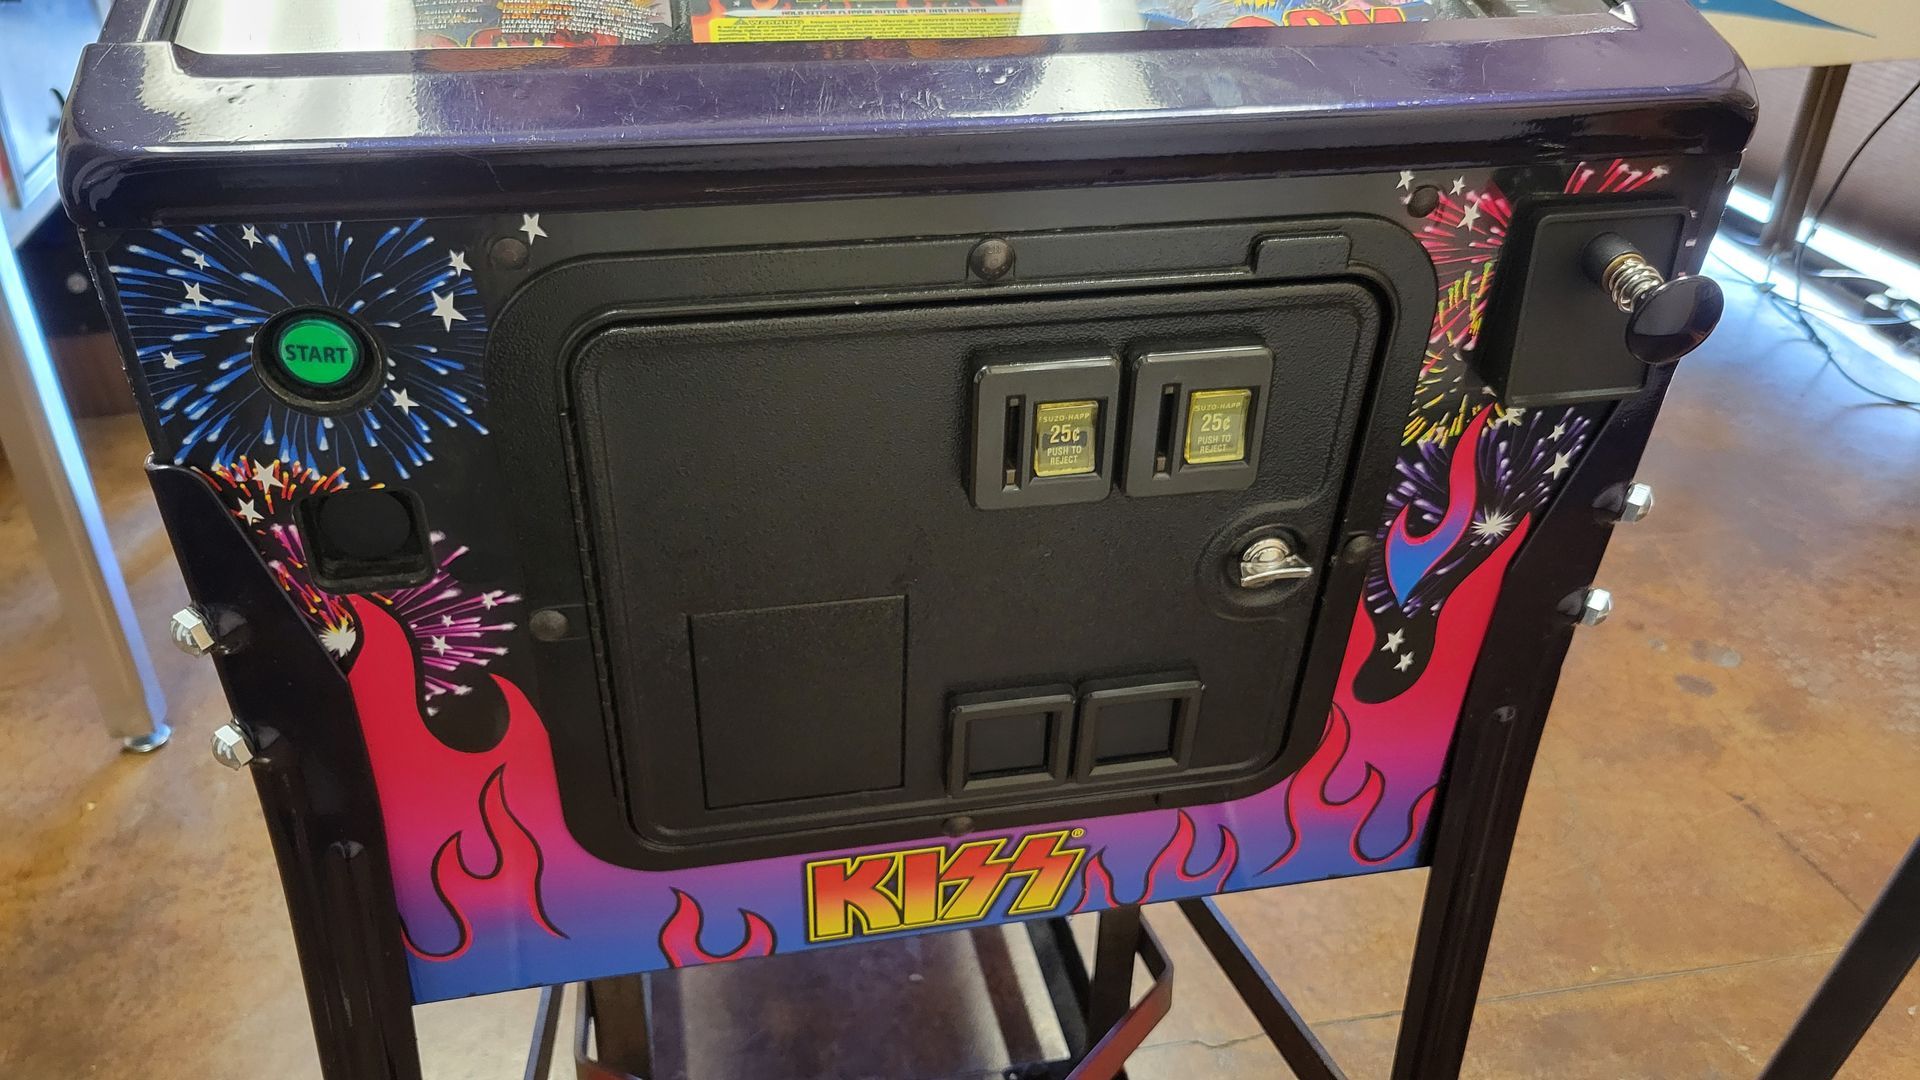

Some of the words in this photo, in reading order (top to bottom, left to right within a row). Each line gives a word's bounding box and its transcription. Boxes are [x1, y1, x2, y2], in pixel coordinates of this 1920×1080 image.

[285, 344, 348, 364] START
[1201, 412, 1231, 432] 25¢
[1050, 424, 1080, 444] 25¢
[1198, 435, 1219, 445] PUSH
[1221, 434, 1232, 443] TO
[1047, 446, 1069, 456] PUSH
[1072, 445, 1082, 455] TO
[1199, 443, 1227, 454] REJECT
[1050, 455, 1078, 466] REJECT
